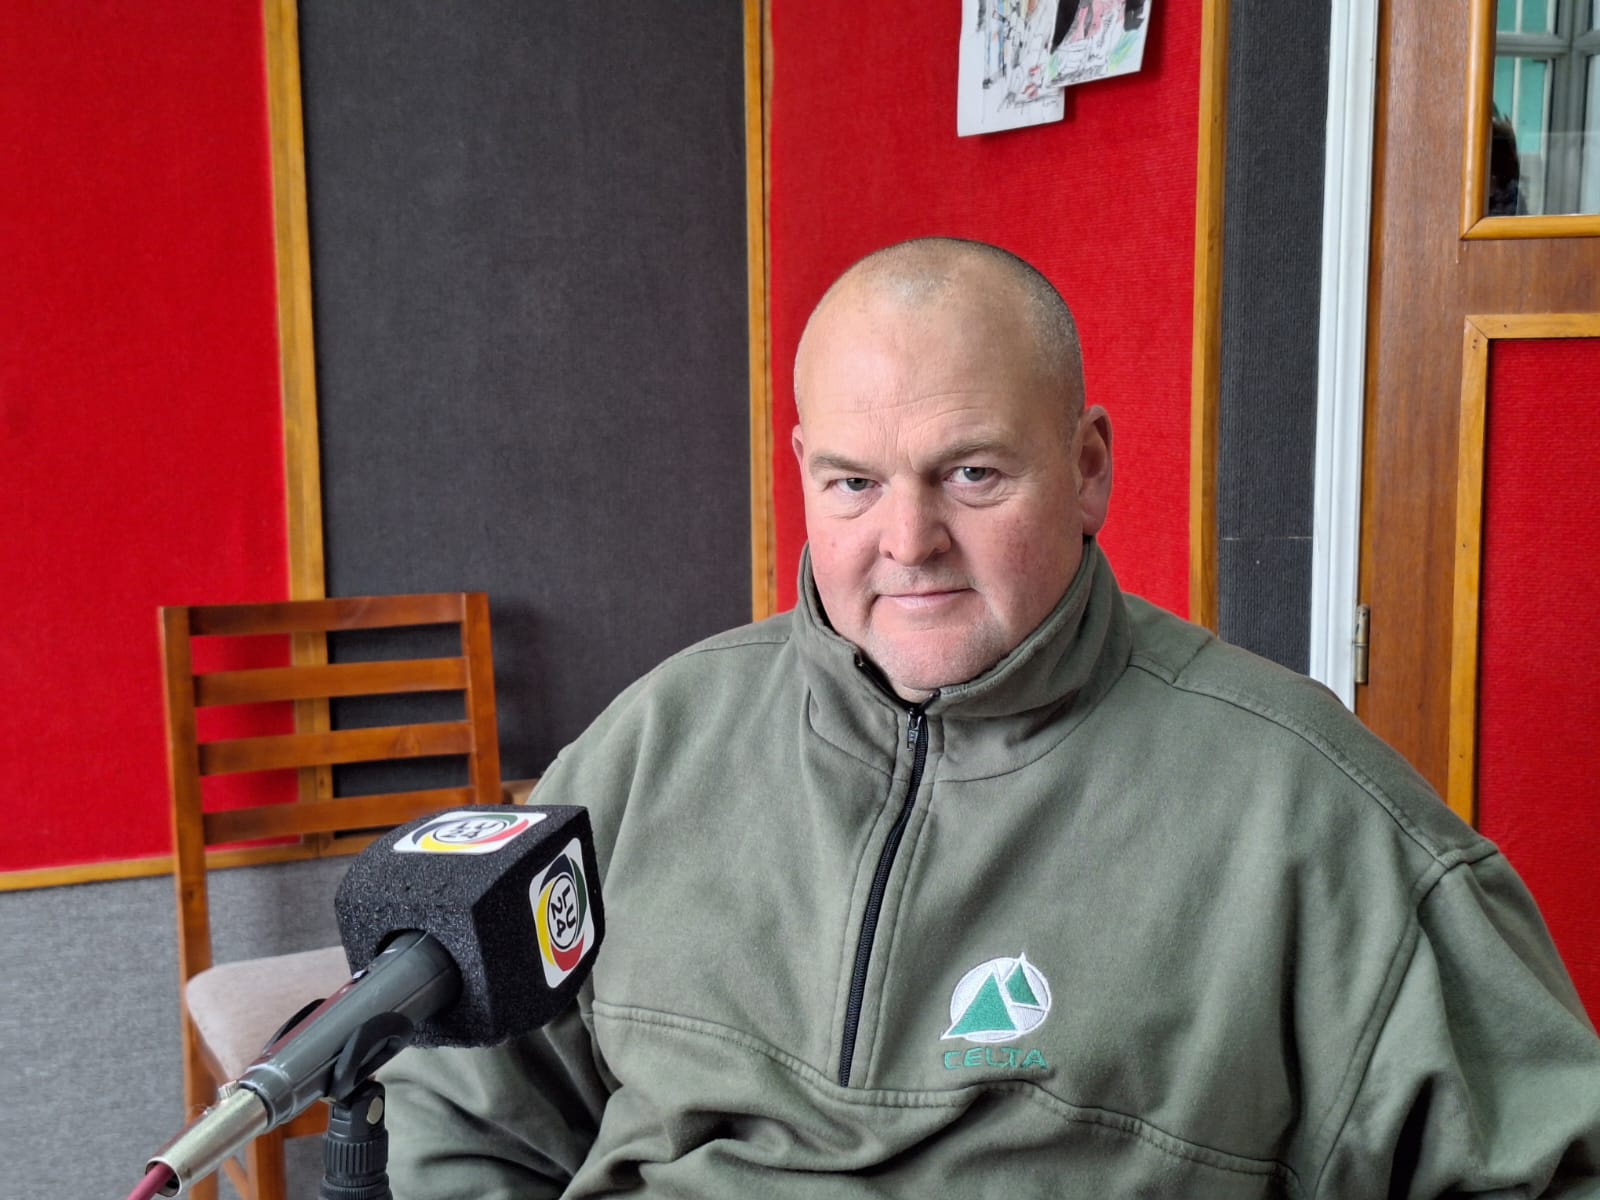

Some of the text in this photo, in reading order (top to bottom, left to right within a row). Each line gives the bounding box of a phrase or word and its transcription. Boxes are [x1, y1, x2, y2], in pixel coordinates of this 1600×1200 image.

[550, 896, 567, 938] 24
[561, 884, 576, 929] LU
[943, 1047, 1049, 1070] CELTA
